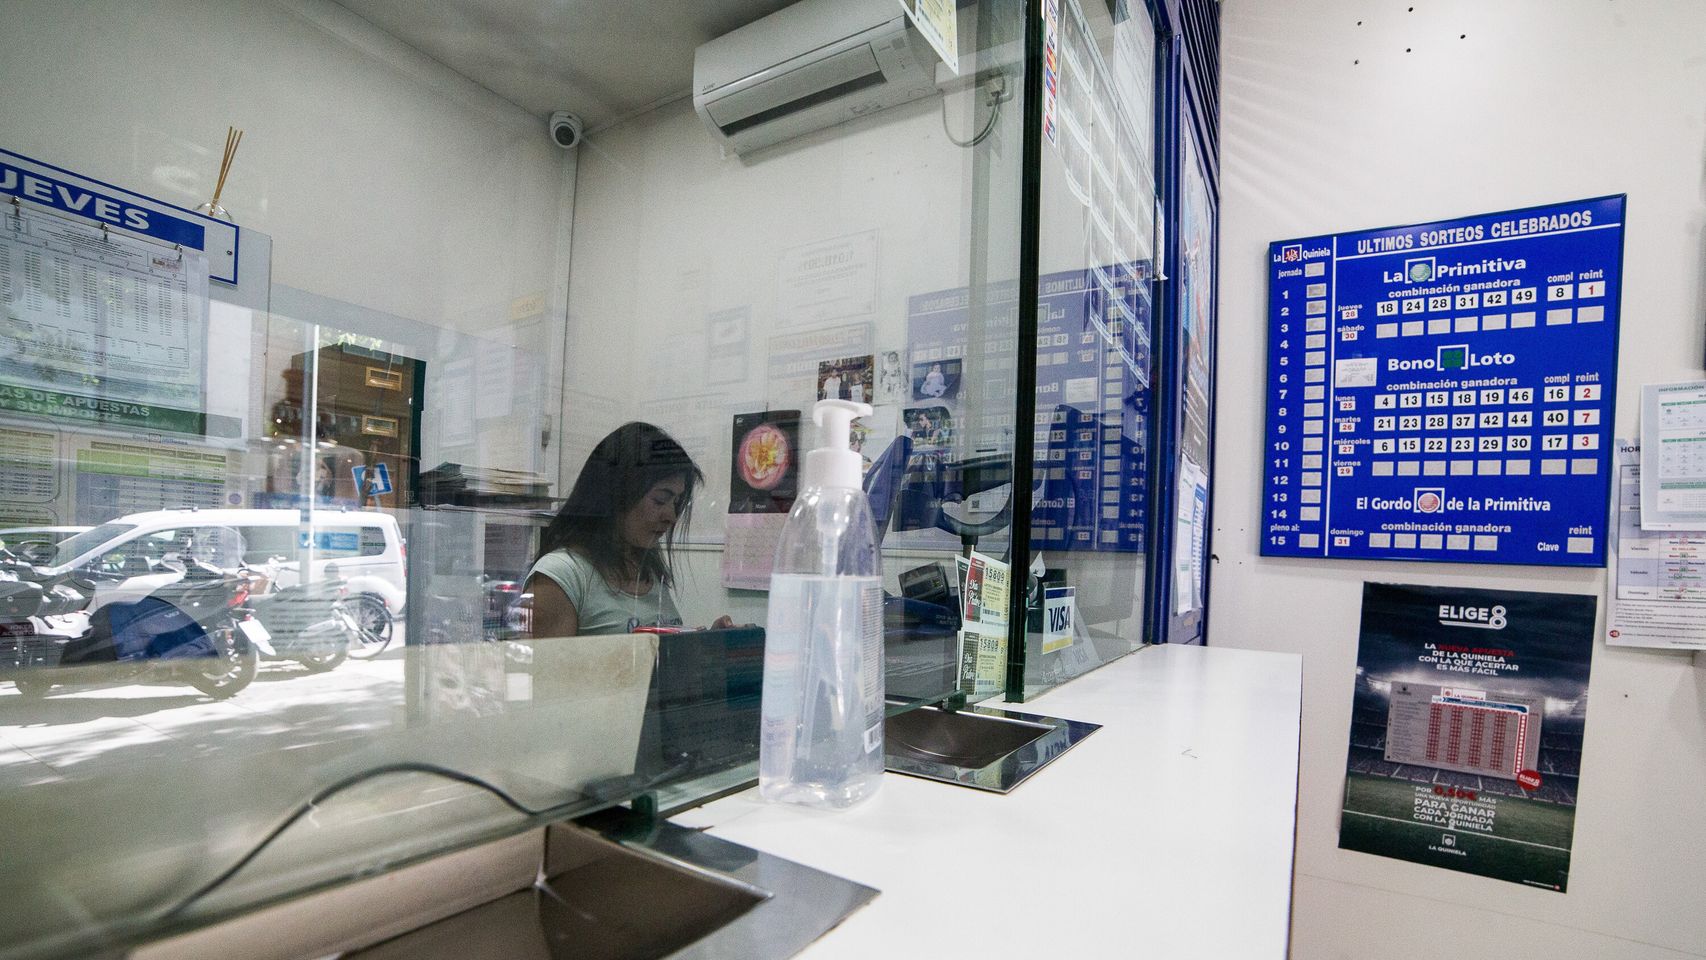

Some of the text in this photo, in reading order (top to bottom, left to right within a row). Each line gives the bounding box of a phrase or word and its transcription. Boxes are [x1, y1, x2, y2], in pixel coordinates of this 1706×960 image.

[1357, 210, 1592, 254] ULTIMOS SORTEOS CELEBRADOS
[1273, 254, 1281, 262] La
[1302, 247, 1331, 259] Quiniela
[1278, 266, 1302, 279] jornada
[1384, 258, 1526, 284] La Primitiva
[1547, 269, 1603, 283] compl reint
[1388, 278, 1521, 299] combinación ganadora
[1556, 288, 1565, 298] 8
[1588, 285, 1594, 295] 1
[1282, 290, 1289, 299] 1
[1487, 294, 1502, 305] 42
[1516, 290, 1533, 301] 49
[1406, 301, 1421, 312] 24
[1432, 299, 1447, 309] 28
[1460, 297, 1474, 307] 31
[1280, 307, 1289, 316] 2
[1380, 303, 1393, 314] 18
[1280, 324, 1289, 332] 3
[1280, 340, 1289, 349] 4
[1280, 357, 1288, 366] 5
[1388, 352, 1516, 371] Bono Loto
[1279, 374, 1288, 383] 6
[1544, 372, 1600, 385] compl reint
[1386, 377, 1518, 391] combinación ganadora
[1279, 390, 1288, 400] 7
[1458, 393, 1471, 404] 18
[1485, 392, 1500, 402] 19
[1512, 391, 1529, 401] 46
[1549, 388, 1564, 399] 16
[1583, 388, 1591, 399] 2
[31, 391, 58, 404] DE
[62, 396, 150, 417] APUESTAS
[1382, 397, 1389, 406] 4
[1404, 395, 1418, 405] 13
[1430, 394, 1444, 404] 15
[1278, 408, 1287, 416] 8
[1378, 418, 1392, 428] 21
[1403, 418, 1418, 428] 23
[1429, 416, 1444, 427] 28
[1456, 416, 1470, 427] 37
[1483, 415, 1499, 425] 42
[1511, 414, 1528, 424] 44
[1547, 413, 1564, 423] 40
[1582, 413, 1590, 423] 7
[1278, 425, 1286, 433] 9
[1274, 442, 1290, 450] 10
[1381, 442, 1388, 451] 6
[1402, 440, 1416, 450] 15
[1428, 440, 1443, 450] 22
[1455, 440, 1470, 450] 23
[1482, 439, 1498, 449] 29
[1511, 438, 1528, 448] 30
[1547, 438, 1562, 448] 17
[1582, 436, 1589, 447] 3
[1274, 458, 1289, 468] 11
[1273, 476, 1289, 485] 12
[1272, 493, 1288, 502] 13
[1356, 496, 1551, 512] El Gordo de la Primitiva
[1271, 510, 1287, 519] 14
[1270, 523, 1290, 532] pleno
[1330, 528, 1364, 536] domingo
[1381, 521, 1512, 534] combinación ganadora
[1568, 525, 1592, 535] reint
[1270, 536, 1286, 545] 15
[1537, 542, 1560, 552] Clave
[1048, 605, 1071, 633] VISA
[1424, 642, 1437, 650] LA
[1460, 652, 1505, 663] QUINIELA
[1418, 655, 1438, 663] CON
[1453, 659, 1474, 667] QUE
[1475, 661, 1519, 671] ACERTAR
[1436, 663, 1499, 676] ES MÁS FÁCIL
[1478, 796, 1497, 804] MÁS
[1414, 797, 1496, 818] PARA GANAR
[1414, 806, 1494, 825] CADA JORNADA
[1413, 813, 1493, 832] CON LA QUINIELA
[1438, 847, 1467, 857] QUINIELA
